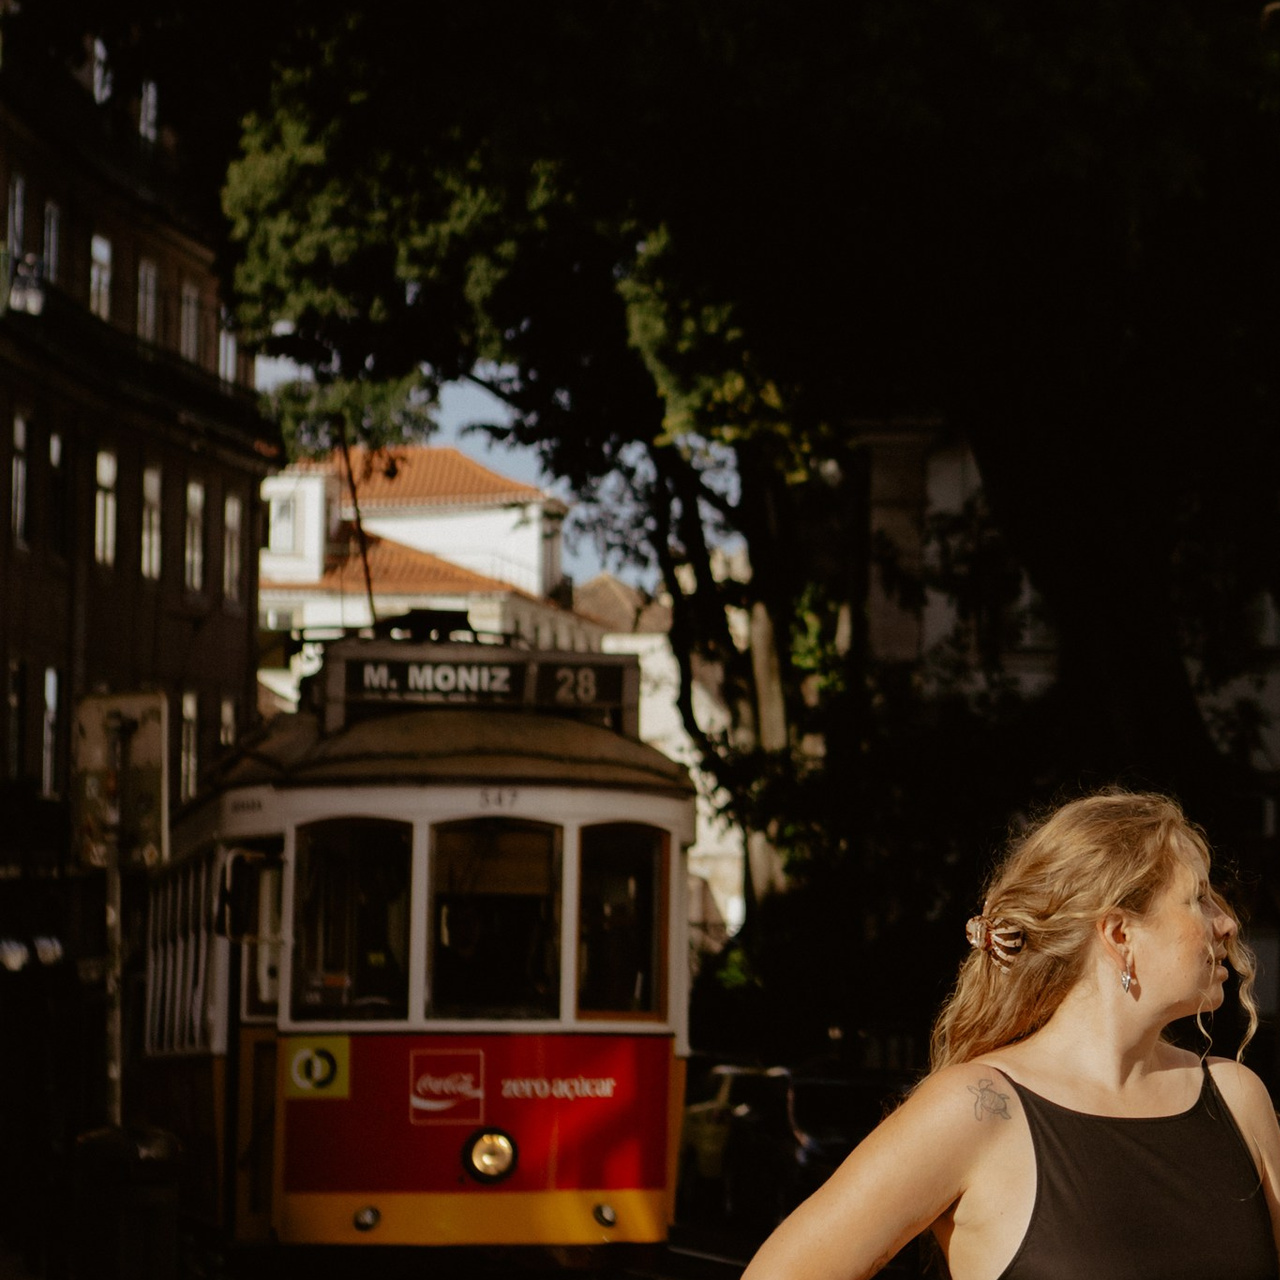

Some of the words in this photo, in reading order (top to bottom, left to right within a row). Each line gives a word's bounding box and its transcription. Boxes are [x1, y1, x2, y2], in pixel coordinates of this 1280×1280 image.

[363, 664, 396, 689] M.
[407, 664, 510, 693] MONIZ
[555, 668, 597, 704] 28
[500, 1077, 550, 1099] zero
[551, 1074, 616, 1102] açúcar
